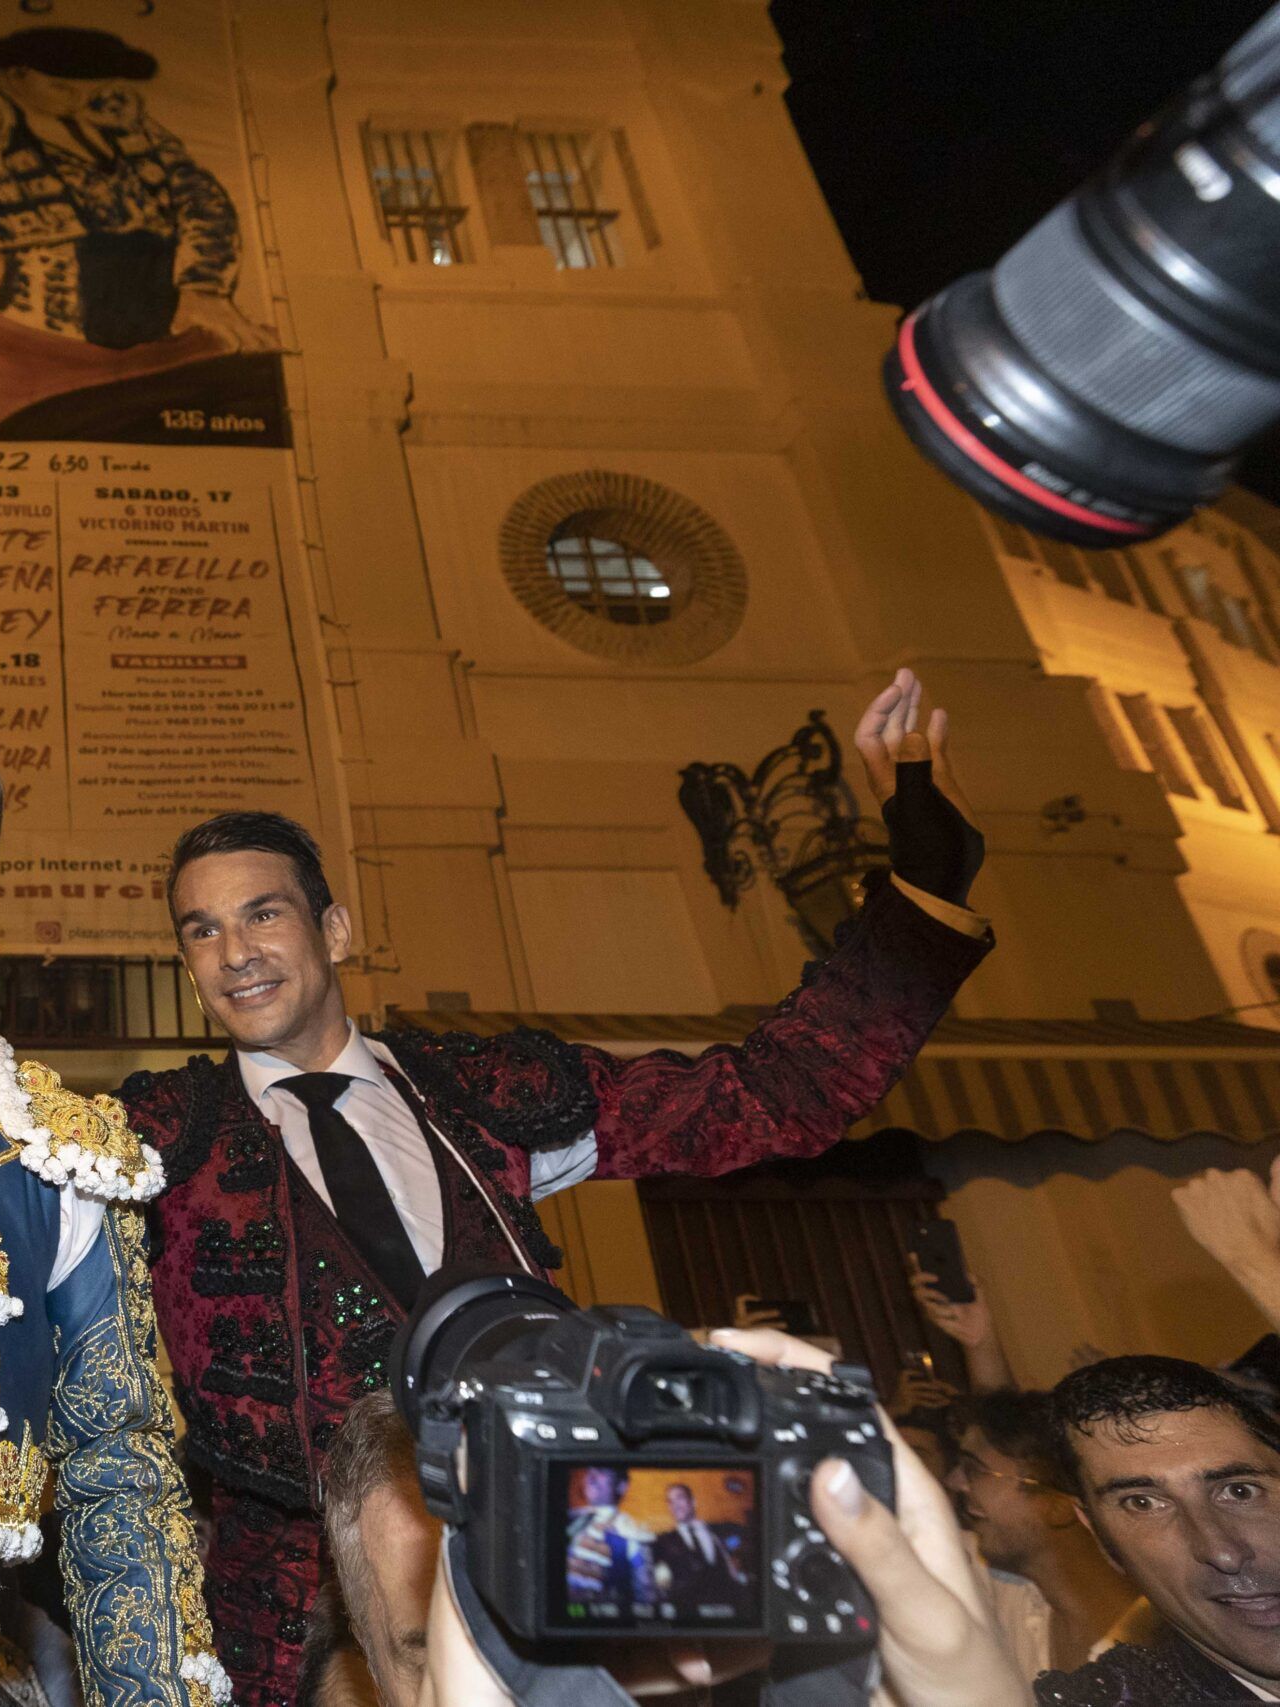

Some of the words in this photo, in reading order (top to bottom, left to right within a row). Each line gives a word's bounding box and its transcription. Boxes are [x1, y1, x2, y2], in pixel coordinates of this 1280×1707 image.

[210, 413, 265, 432] años
[208, 491, 232, 503] 17
[125, 505, 136, 517] 6
[145, 505, 201, 518] TOROS
[80, 518, 175, 532] VICTORINO
[182, 520, 250, 534] MARTIN
[69, 554, 269, 581] RAFAELILLO
[93, 597, 251, 620] FERRERA
[0, 860, 34, 875] por
[40, 858, 122, 873] Internet
[129, 864, 138, 872] a
